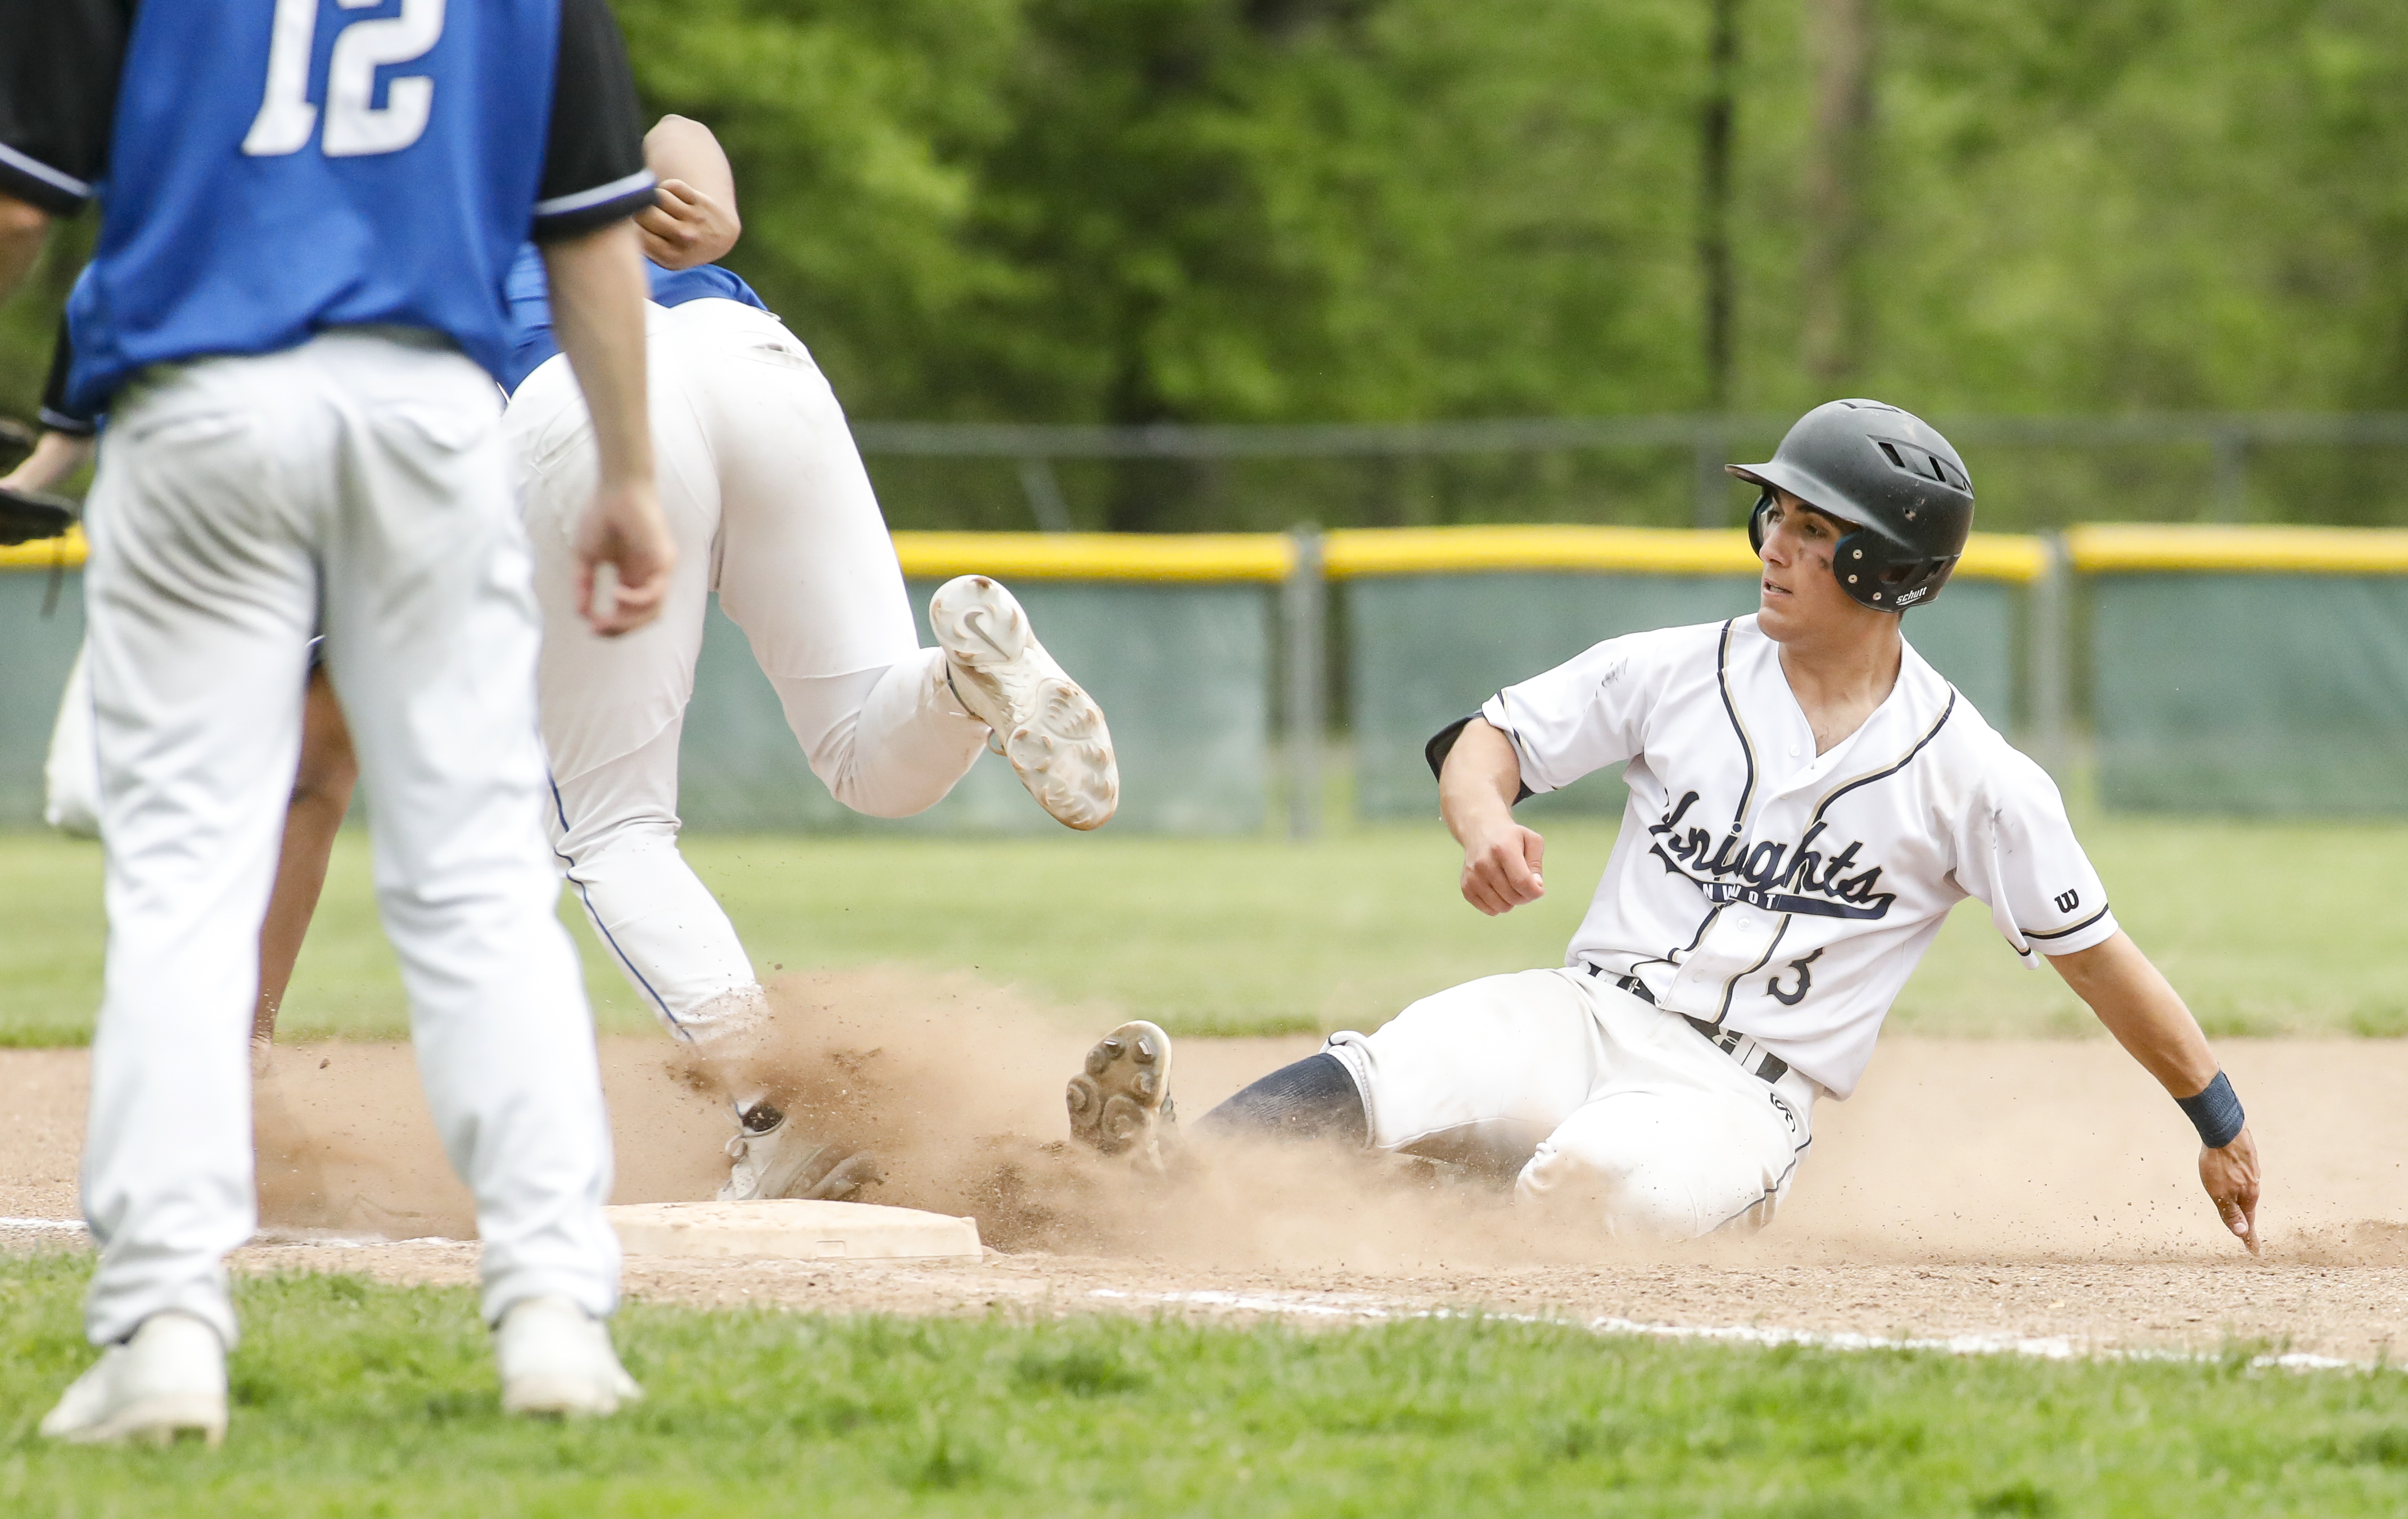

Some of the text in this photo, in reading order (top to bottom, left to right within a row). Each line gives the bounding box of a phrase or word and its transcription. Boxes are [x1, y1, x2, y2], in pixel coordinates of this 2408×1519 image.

[240, 0, 446, 157] 12
[1895, 586, 1927, 605] schutt
[1765, 946, 1823, 1006] 3
